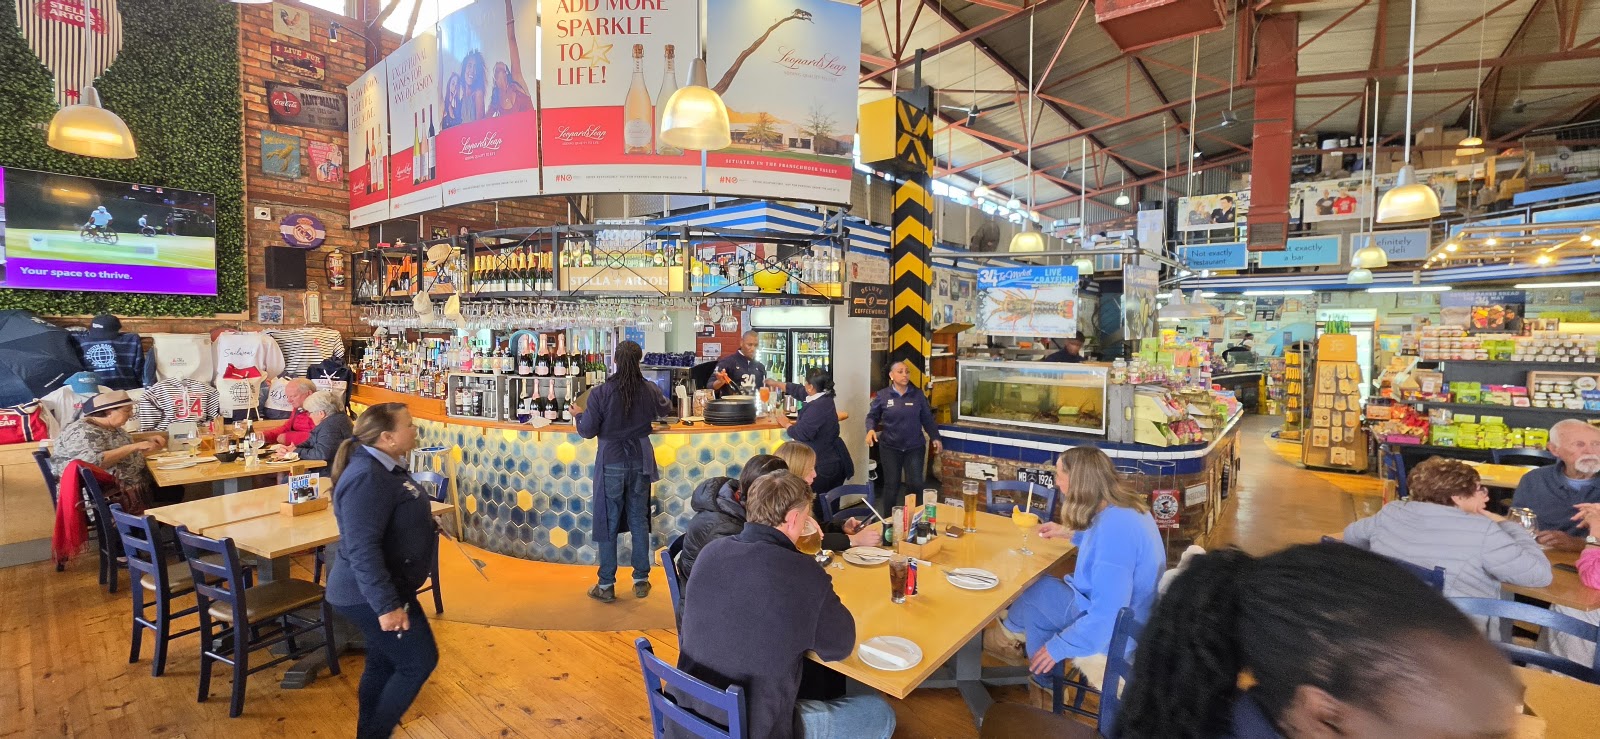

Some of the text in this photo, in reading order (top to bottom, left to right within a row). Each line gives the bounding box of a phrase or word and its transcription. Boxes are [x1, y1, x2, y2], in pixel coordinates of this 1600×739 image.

[556, 0, 668, 13] ADD MORE
[556, 16, 651, 38] SPARKLE
[284, 47, 301, 56] LIVE
[306, 53, 321, 63] FOR
[557, 42, 584, 61] TO
[392, 48, 427, 80] EXCEPTIONAL
[392, 66, 422, 92] WINES FOR
[557, 66, 606, 85] LIFE!
[405, 74, 433, 99] OCCASION
[725, 158, 754, 166] SITUATED
[1294, 242, 1323, 251] exactly
[1375, 236, 1412, 245] efinitely
[1208, 249, 1232, 257] exactly
[1388, 246, 1406, 254] deli
[1193, 258, 1226, 266] restaurant
[1291, 253, 1304, 261] bar
[20, 266, 133, 280] Your space to thrive.
[980, 269, 998, 287] 34
[1044, 267, 1062, 276] LIVE
[571, 276, 669, 286] STELLA ARTOIS
[1034, 276, 1073, 284] CRAYFISH
[860, 286, 884, 295] DELUXE
[741, 374, 756, 390] 34
[174, 398, 204, 419] 34
[291, 479, 308, 489] CLUB
[1018, 472, 1053, 486] MB 1926
